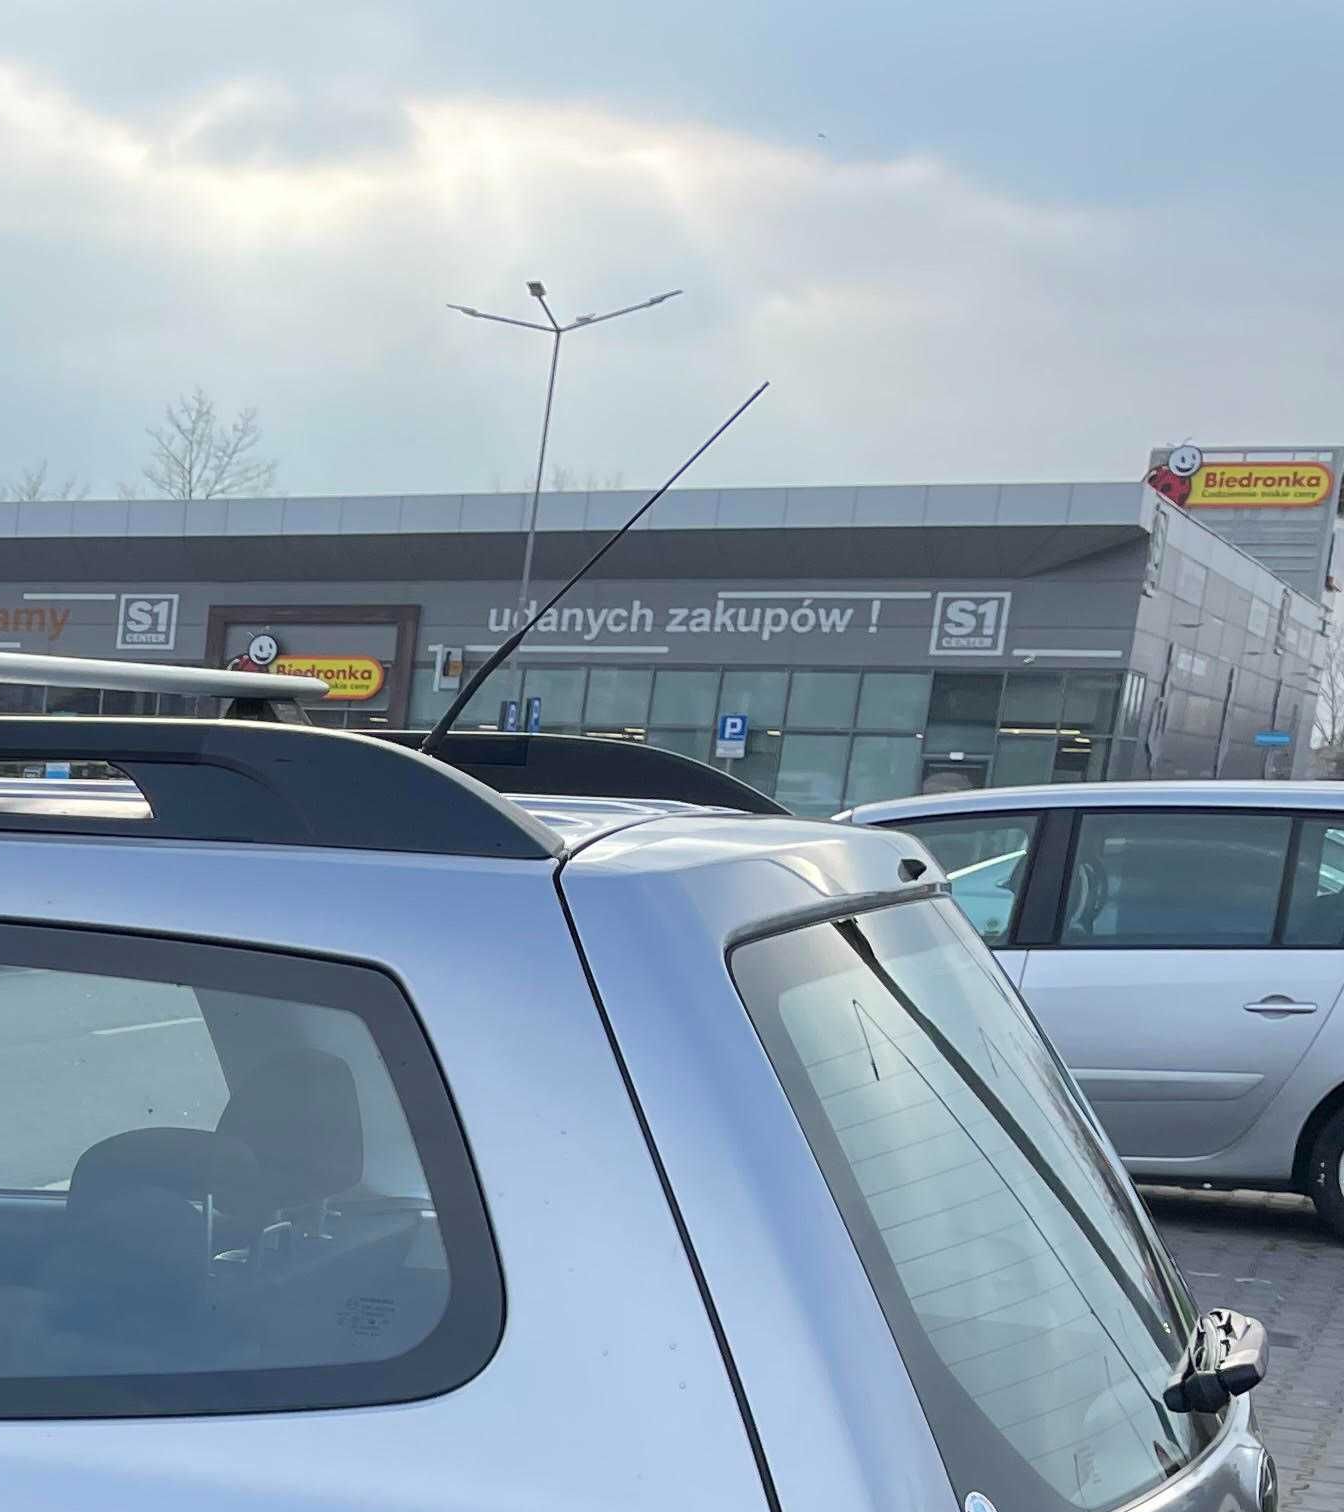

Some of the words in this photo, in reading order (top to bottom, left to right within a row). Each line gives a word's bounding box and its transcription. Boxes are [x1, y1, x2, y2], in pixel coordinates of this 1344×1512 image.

[1204, 472, 1321, 488] Biedronka
[126, 600, 170, 633] S1
[488, 600, 654, 641] udanych
[666, 599, 854, 641] zakupów
[944, 600, 1000, 636] S1
[126, 633, 167, 643] CENTER
